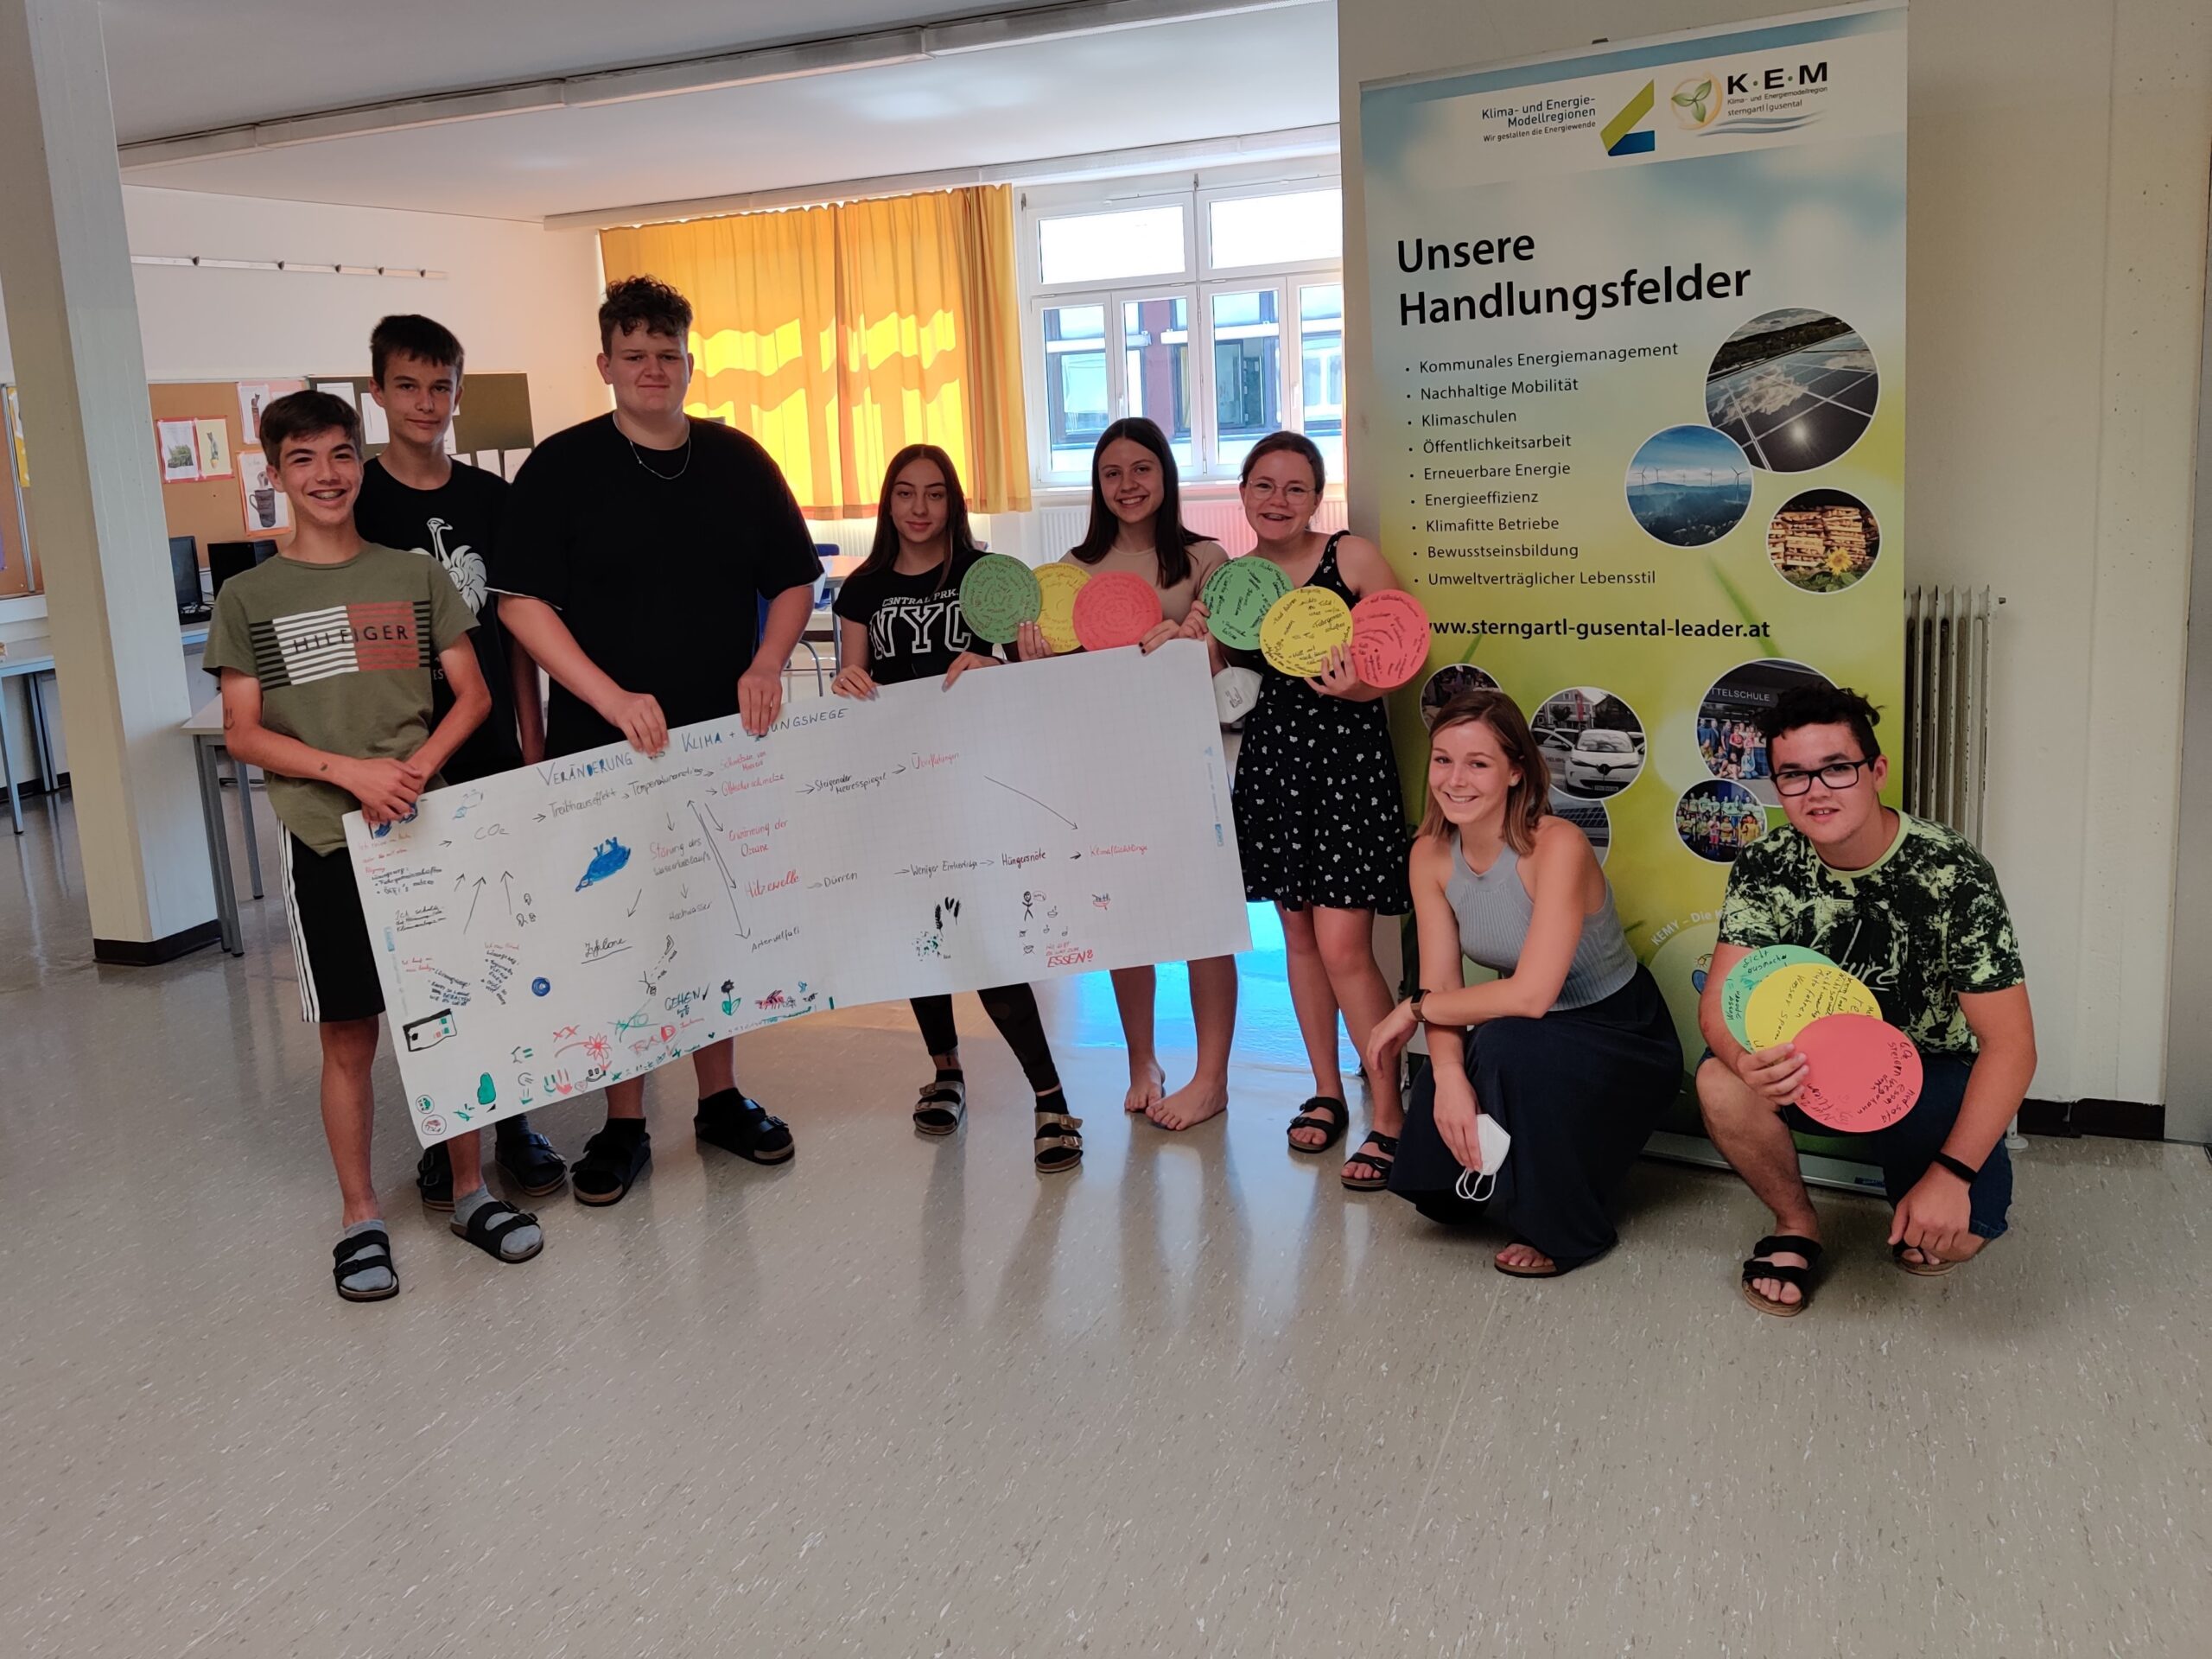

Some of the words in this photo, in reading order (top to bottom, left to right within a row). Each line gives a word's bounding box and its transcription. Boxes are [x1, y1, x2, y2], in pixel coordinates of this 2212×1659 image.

[1482, 108, 1519, 119] Klima-
[1522, 101, 1542, 113] und
[1547, 95, 1595, 110] Energie-
[1508, 108, 1595, 128] Modellregionen
[1497, 130, 1529, 142] gestalten
[1544, 121, 1596, 134] Energiewende
[1397, 234, 1535, 273] Unsere
[1400, 263, 1751, 326] Handlungsfelder
[1420, 355, 1513, 373] Kommunales
[1518, 343, 1679, 367] Energiemanagement
[1421, 384, 1507, 400] Nachhaltige
[1511, 378, 1579, 394] Mobilität
[1421, 410, 1517, 427] Klimaschulen
[1423, 435, 1572, 454] Öffentlichkeitsarbeit
[1424, 465, 1511, 480] Erneuerbare
[1516, 462, 1571, 477] Energie
[1425, 492, 1539, 508] Energieeffizienz
[1427, 518, 1494, 532] Klimafitte
[1498, 517, 1560, 531] Betriebe
[1427, 543, 1579, 559] Bewusstseinsbildung
[1428, 572, 1575, 588] Umweltverträglicher
[1580, 570, 1656, 584] Lebensstil
[293, 625, 409, 654] HILFIGER
[869, 601, 971, 660] NYC
[682, 733, 722, 753] KLIMA
[1650, 919, 1680, 946] KEMY
[1690, 912, 1712, 923] Die
